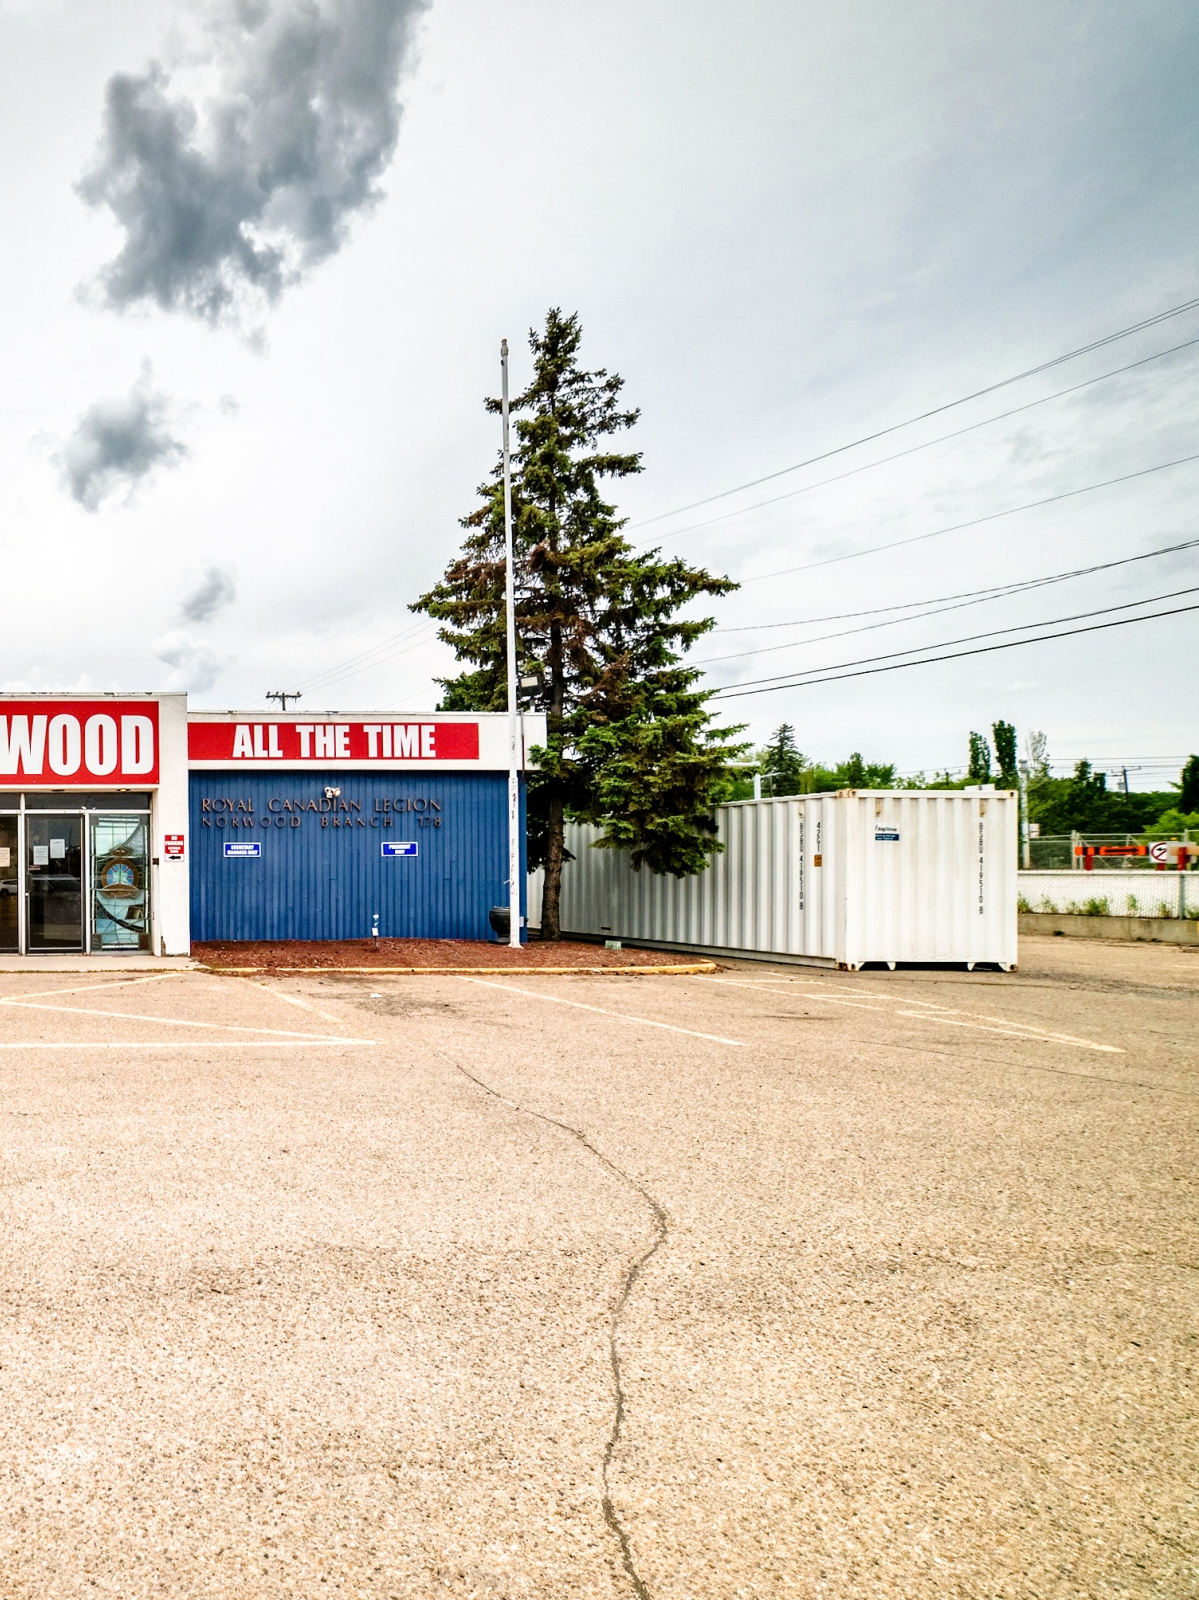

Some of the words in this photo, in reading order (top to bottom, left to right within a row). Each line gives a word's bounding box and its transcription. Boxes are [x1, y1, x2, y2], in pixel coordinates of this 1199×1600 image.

[232, 725, 283, 757] ALL
[296, 725, 351, 757] THE
[363, 725, 436, 757] TIME
[202, 798, 255, 813] ROYAL
[268, 798, 362, 813] CANADIAN
[375, 798, 442, 813] LEGION
[202, 816, 301, 828] NORWOOD
[321, 816, 394, 828] BRANCH
[417, 816, 442, 828] 178
